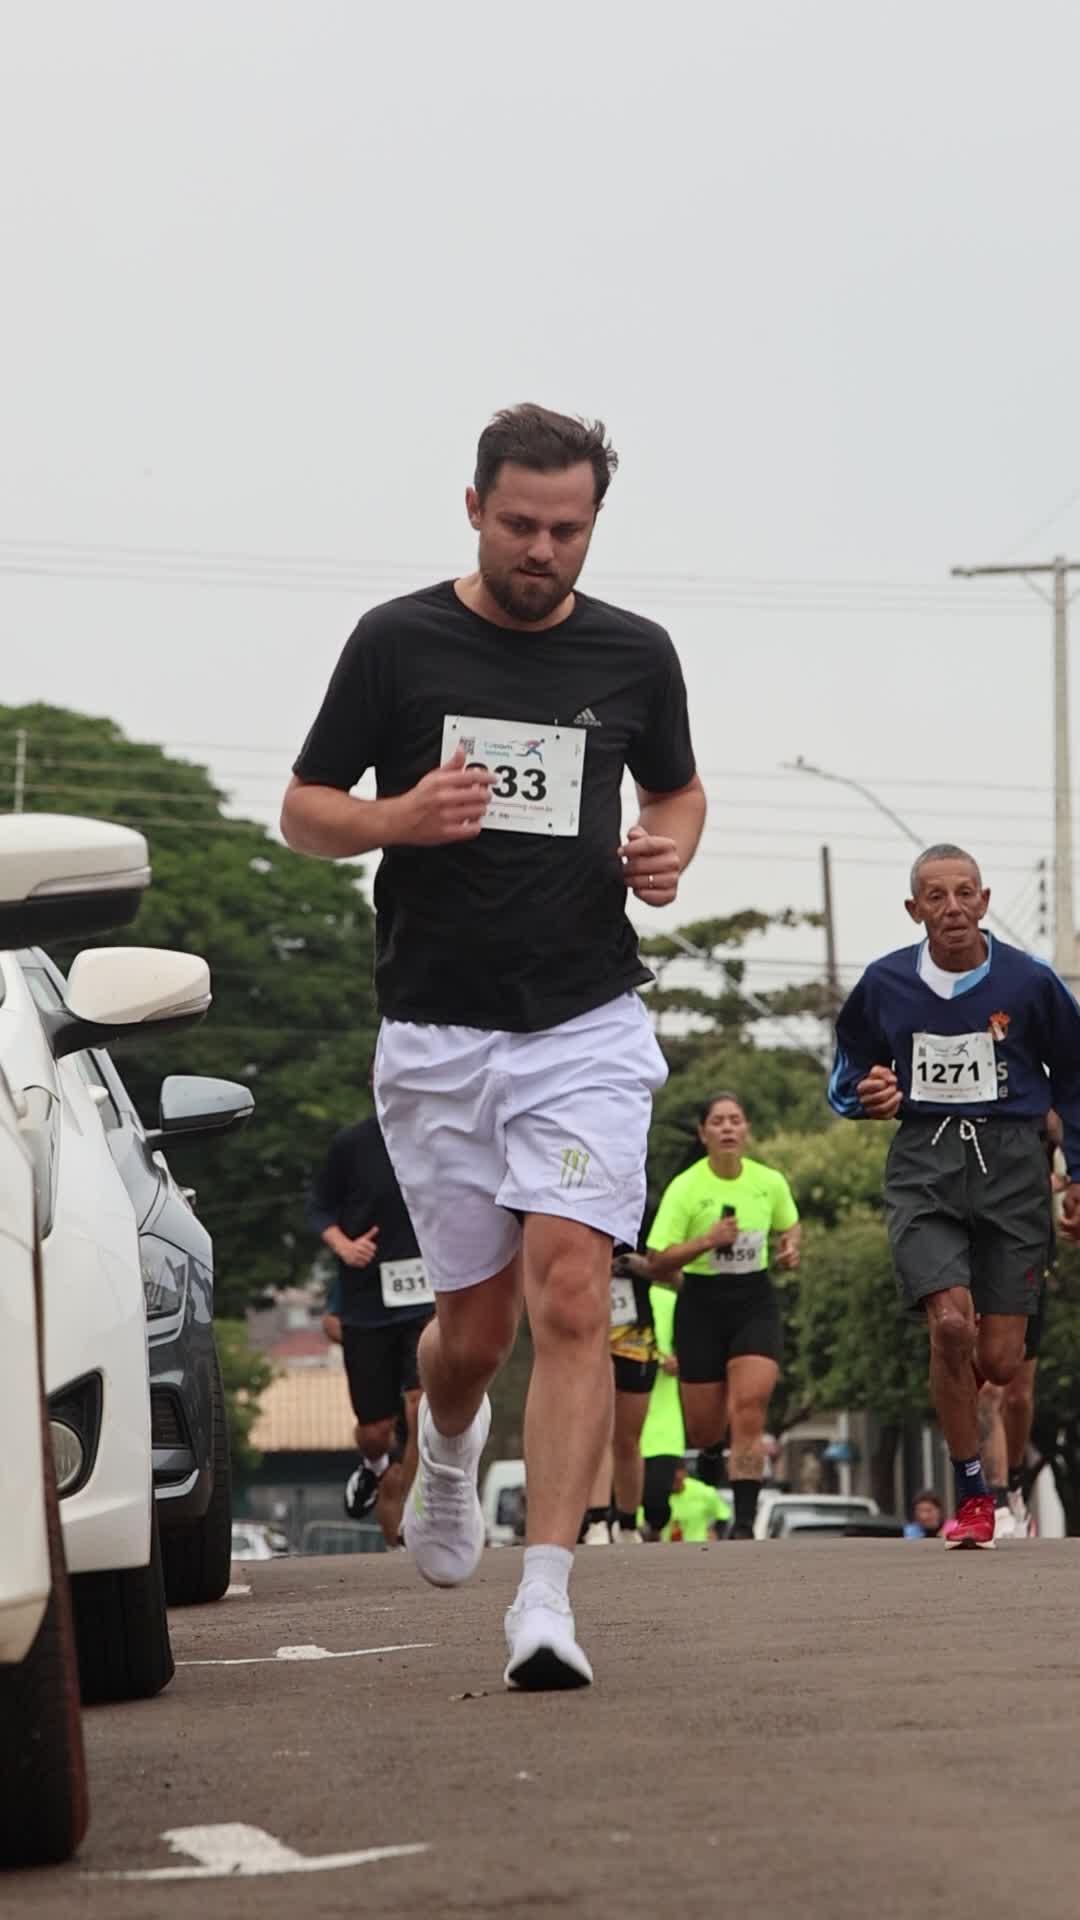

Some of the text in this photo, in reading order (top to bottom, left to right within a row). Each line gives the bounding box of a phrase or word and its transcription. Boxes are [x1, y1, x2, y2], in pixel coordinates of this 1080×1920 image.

[465, 762, 547, 801] 33
[917, 1061, 980, 1084] 1271
[392, 1276, 426, 1292] 831
